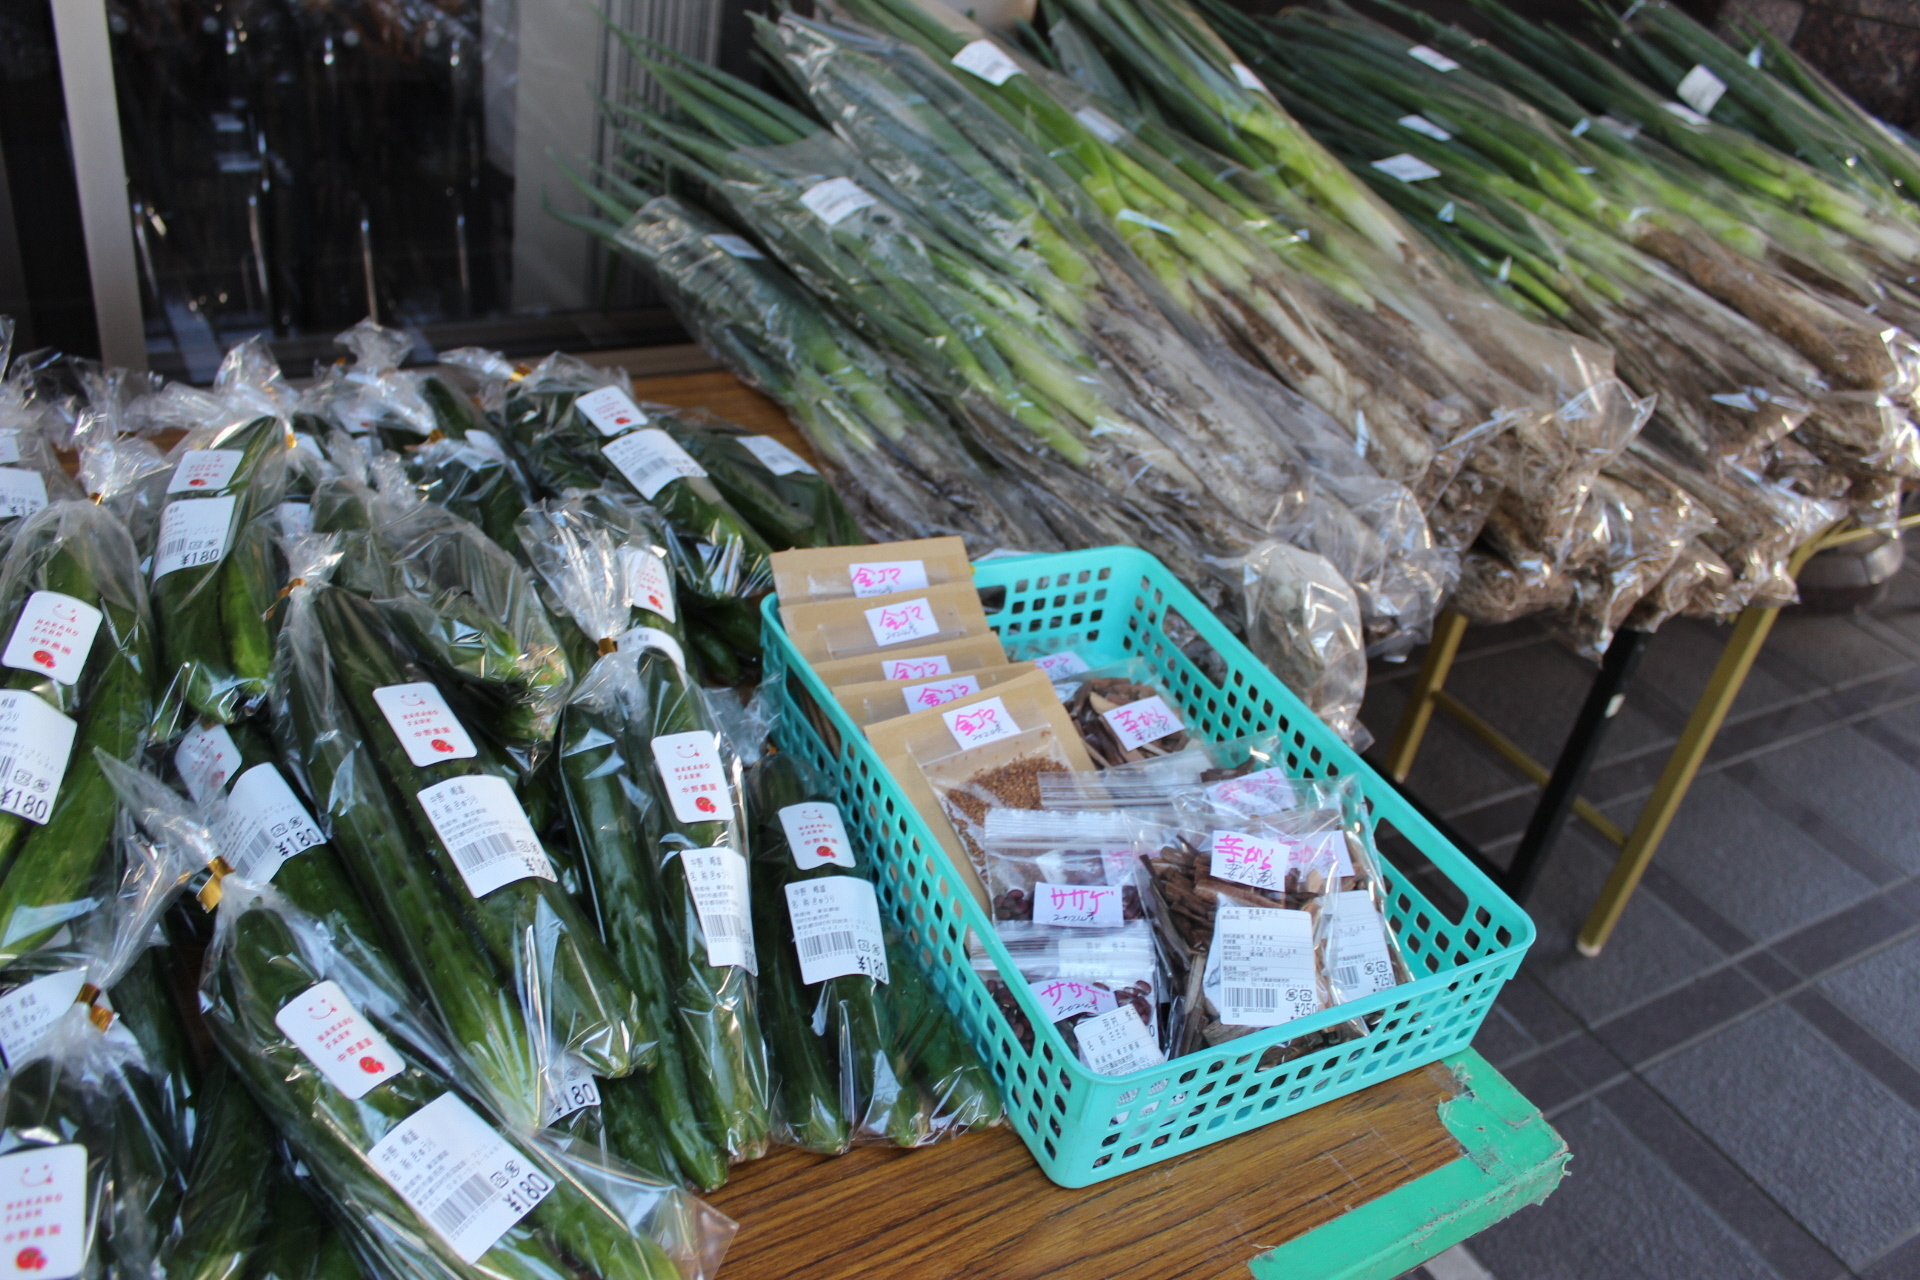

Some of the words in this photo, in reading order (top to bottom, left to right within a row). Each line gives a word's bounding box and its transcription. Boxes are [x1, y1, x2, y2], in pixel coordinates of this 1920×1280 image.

[182, 548, 219, 566] ¥180
[852, 567, 901, 587] 金ゴマ
[36, 618, 79, 636] NAKANO
[879, 605, 925, 631] 金ゴマ
[955, 708, 998, 736] 金ゴマ
[413, 726, 451, 738] 中野農園
[674, 763, 711, 773] NAKANO
[677, 773, 702, 781] FARM
[681, 783, 717, 794] 中野農園
[0, 789, 48, 821] ¥180
[275, 828, 321, 857] ¥180
[1214, 834, 1274, 870] 芋がら
[1051, 887, 1115, 915] ササゲ
[856, 955, 887, 980] ¥180
[1374, 973, 1395, 986] ¥250
[1041, 981, 1111, 1007] ササゲ
[1294, 1002, 1317, 1016] ¥250
[6, 1193, 63, 1210] NAKANO
[501, 1172, 550, 1215] ¥180
[5, 1208, 42, 1222] FARM
[4, 1224, 62, 1243] 中野農園
